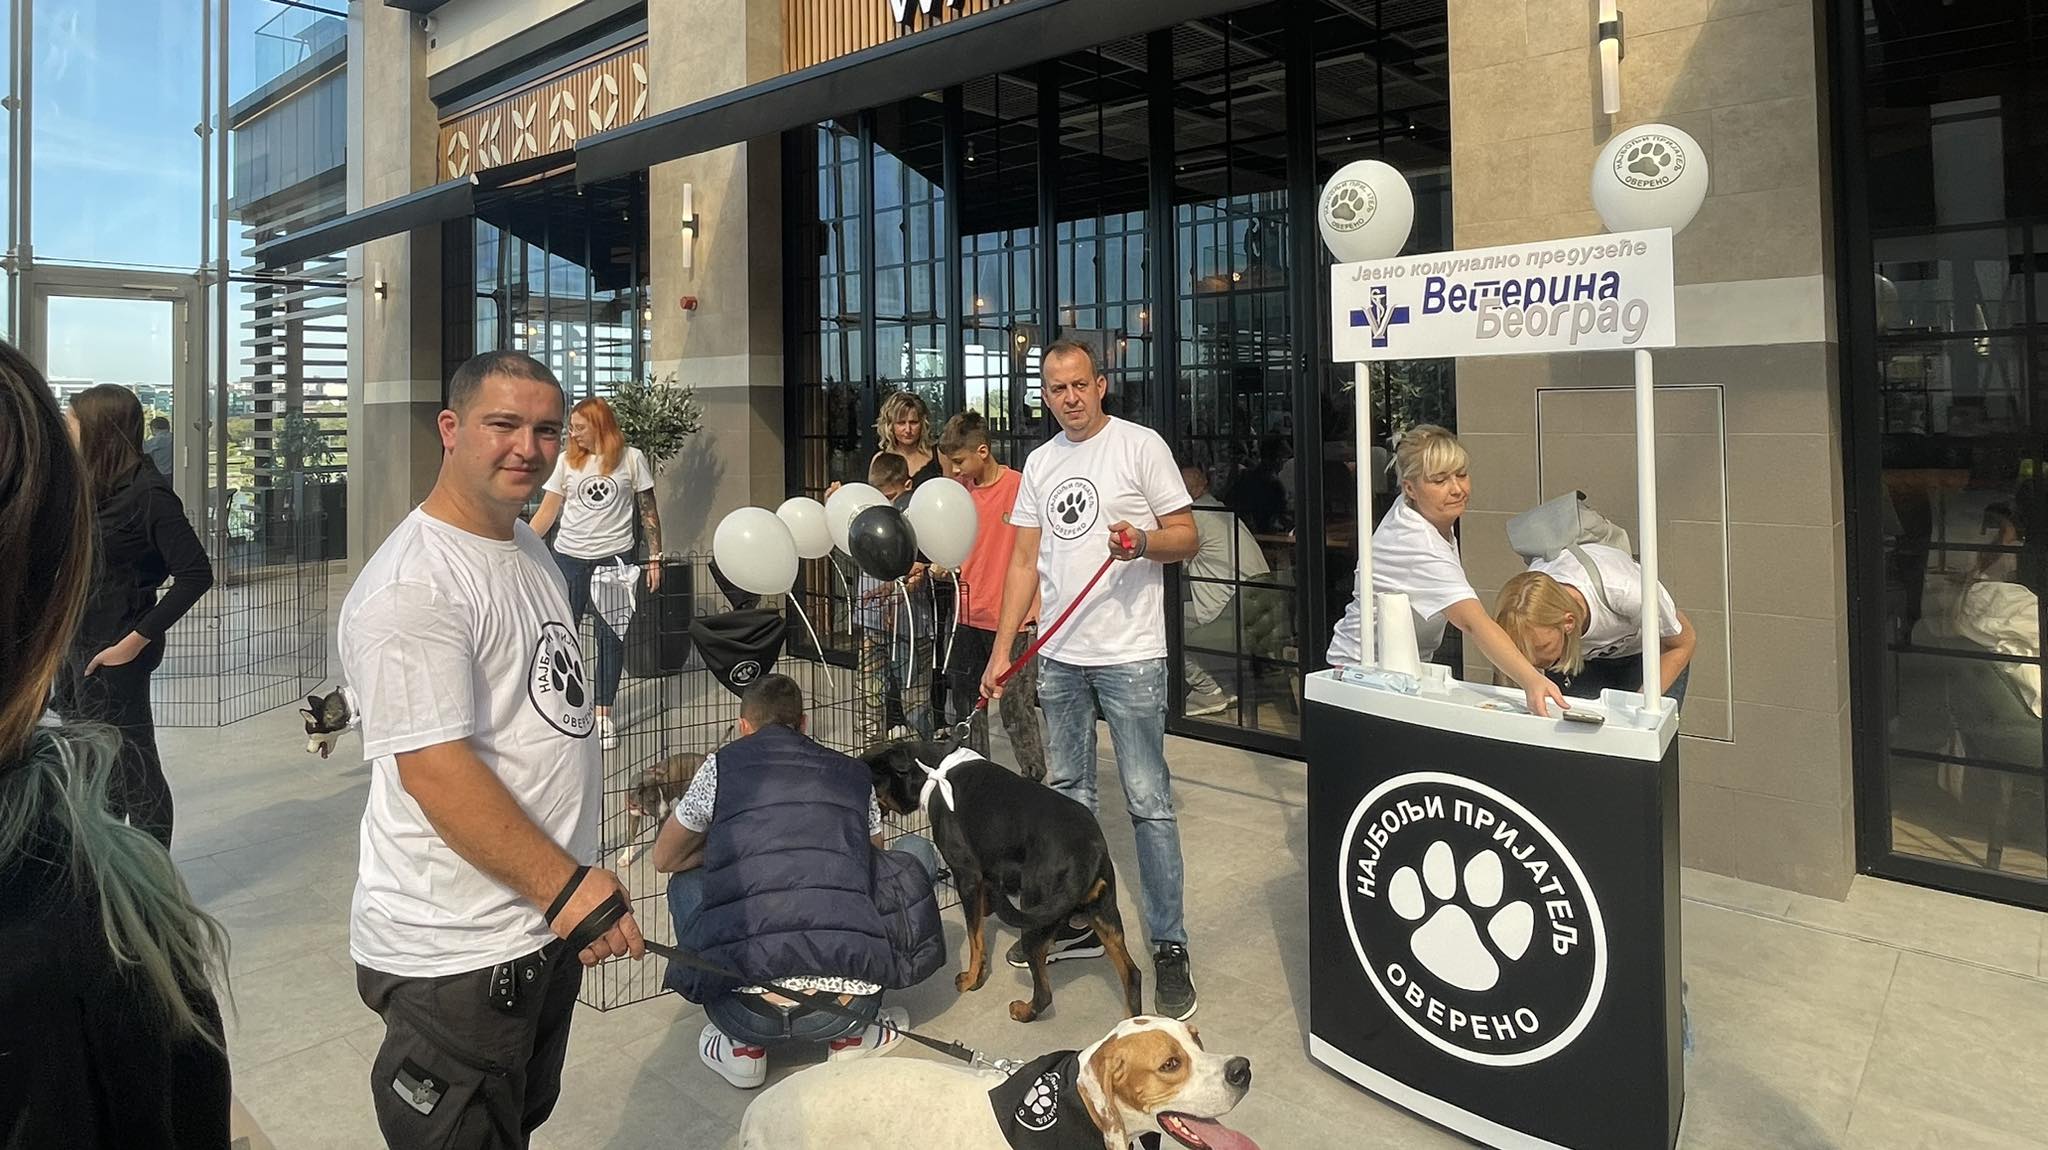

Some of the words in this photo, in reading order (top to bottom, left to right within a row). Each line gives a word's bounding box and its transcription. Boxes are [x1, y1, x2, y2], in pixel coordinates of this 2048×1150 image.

[1625, 176, 1669, 187] ОВЕРЕНО
[1331, 218, 1364, 229] ОВЕРЕНО
[1352, 264, 1405, 282] Јавно
[1410, 253, 1521, 277] комунално
[1526, 239, 1648, 269] предузеће
[1476, 298, 1650, 346] Београд
[1055, 522, 1087, 536] ОВЕРЕНО
[538, 632, 554, 694] НАЈБИ
[1357, 795, 1445, 898] НАЈБОЉИ
[1454, 799, 1578, 956] ПРИЈАТЕЉ
[1385, 962, 1541, 1042] ОВЕРЕНО
